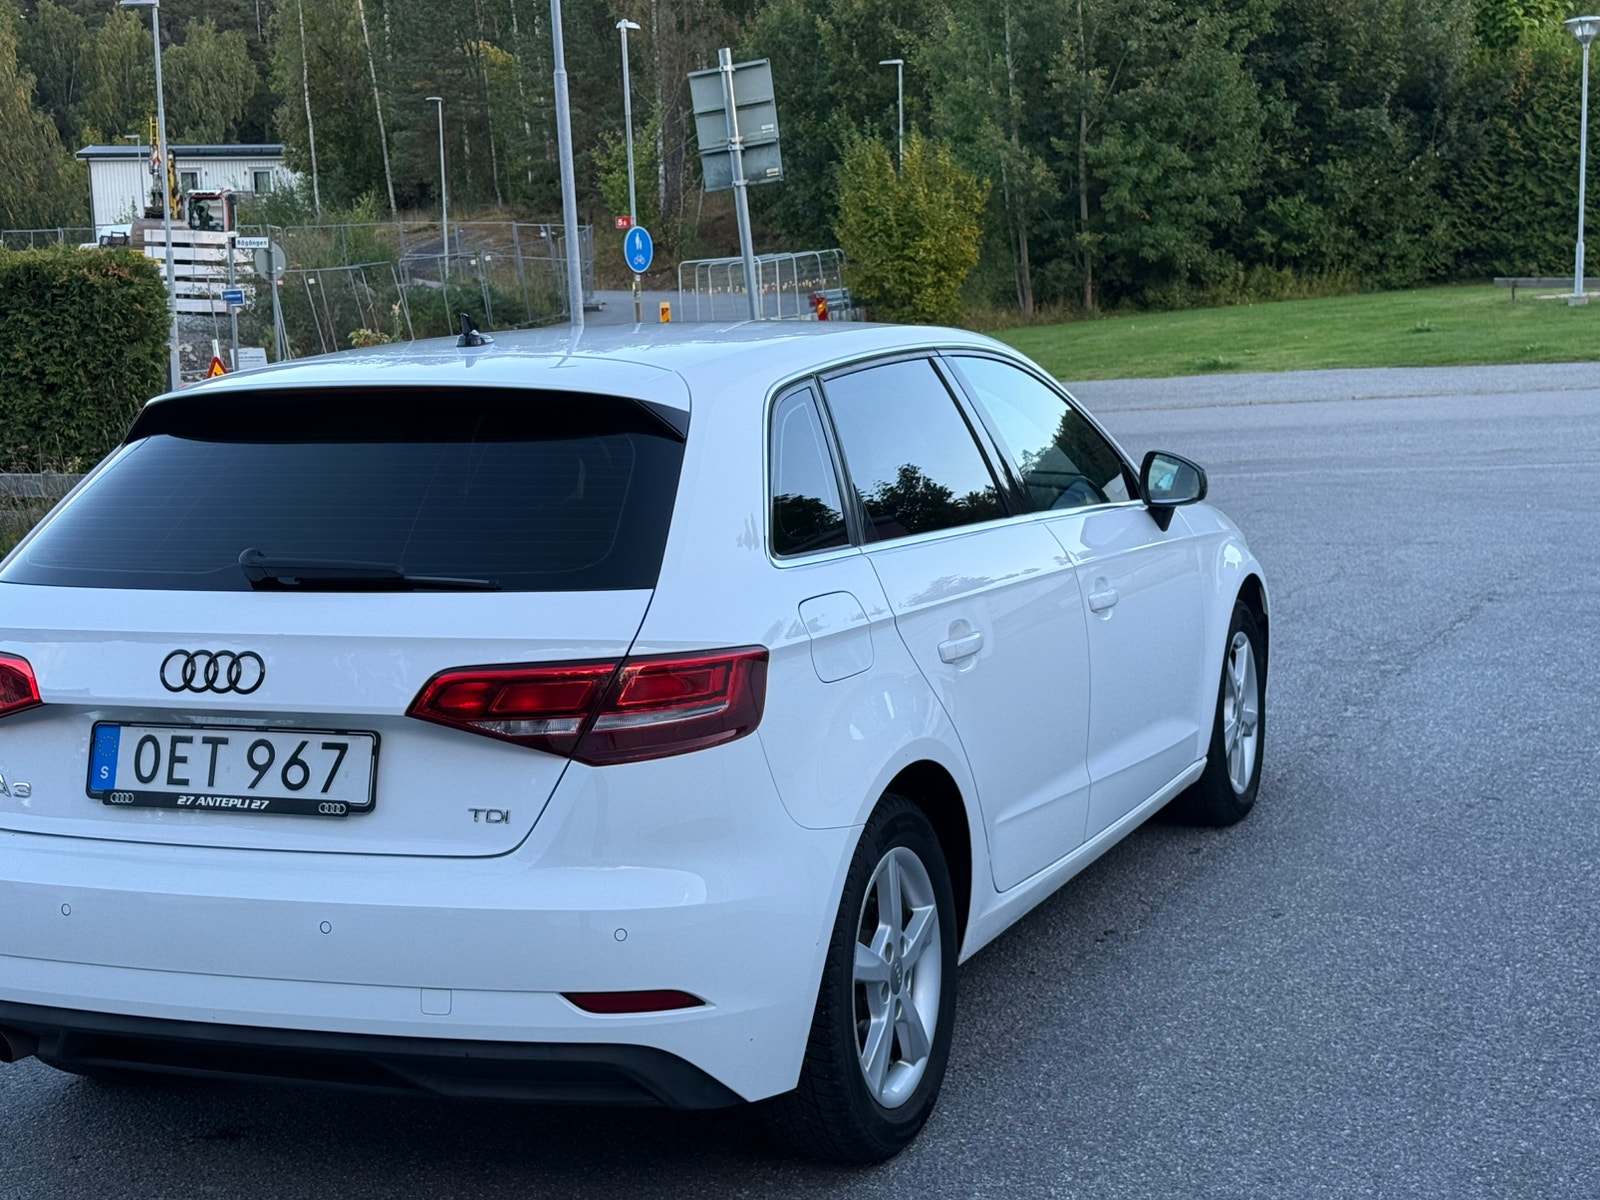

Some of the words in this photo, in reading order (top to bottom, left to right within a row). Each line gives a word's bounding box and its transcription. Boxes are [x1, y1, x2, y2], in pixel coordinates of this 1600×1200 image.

[134, 734, 229, 788] OET
[247, 738, 349, 793] 967
[100, 765, 109, 780] S
[177, 795, 195, 806] 27
[195, 797, 250, 809] ANTEPLI
[250, 799, 270, 810] 27
[467, 808, 511, 825] TDI
